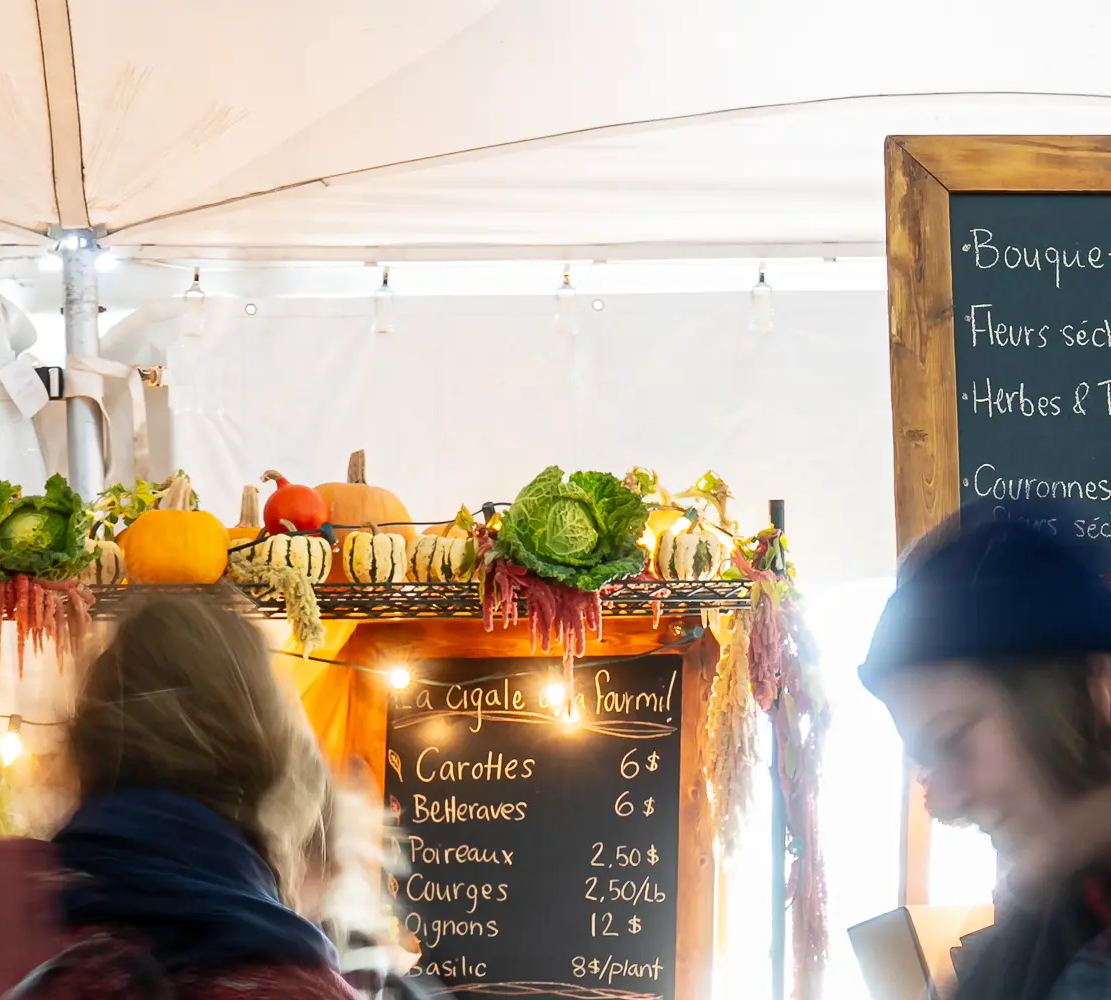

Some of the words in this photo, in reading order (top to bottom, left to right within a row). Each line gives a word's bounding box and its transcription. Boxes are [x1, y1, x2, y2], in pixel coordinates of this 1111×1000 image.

[969, 228, 1111, 289] Bouque
[970, 303, 1050, 348] Fleurs
[972, 377, 1062, 418] Herbes
[1072, 381, 1090, 416] &
[974, 463, 1111, 501] Couronnes
[416, 747, 536, 783] Carottes
[412, 794, 528, 824] Betteraves
[408, 835, 514, 866] Poireaux
[406, 872, 508, 914] Courges
[404, 912, 499, 949] Oignons
